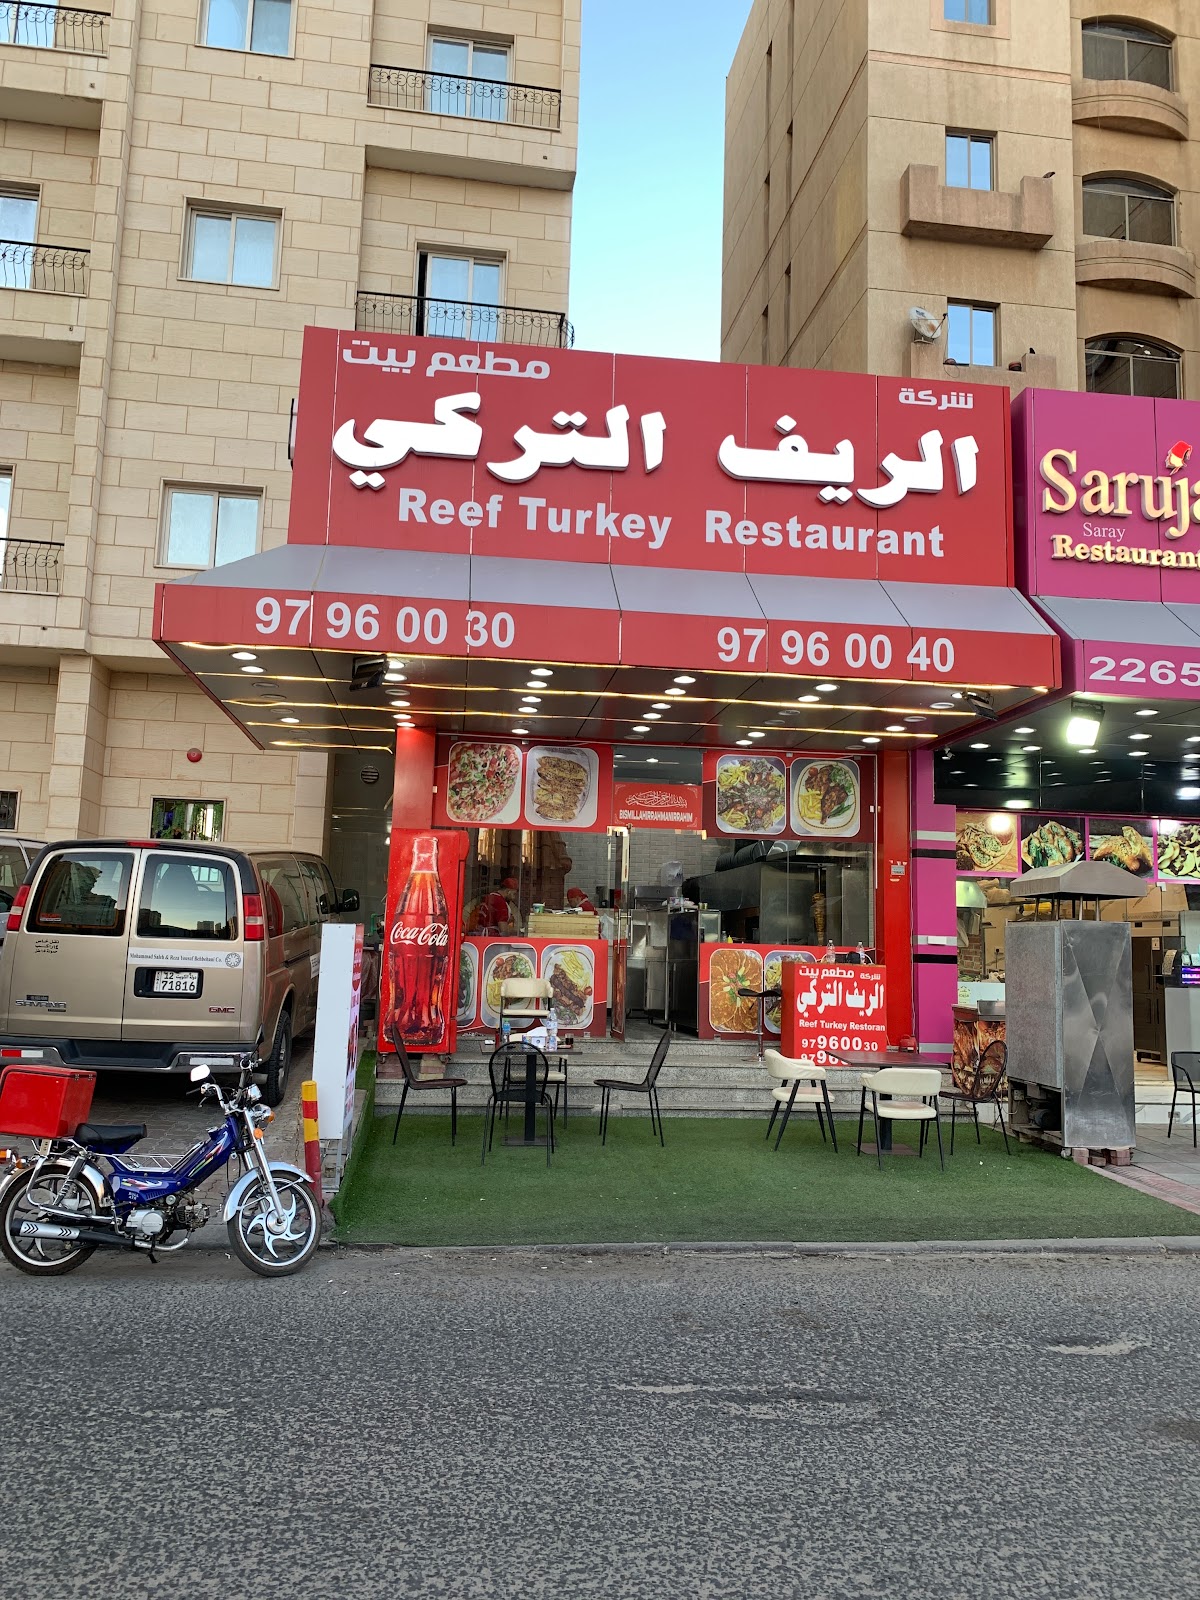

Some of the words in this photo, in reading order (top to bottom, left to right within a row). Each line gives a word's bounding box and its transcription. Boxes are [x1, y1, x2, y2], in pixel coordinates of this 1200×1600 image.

[343, 340, 416, 374] بيت
[426, 351, 550, 379] مطعم
[899, 387, 974, 410] شركة
[332, 391, 666, 490] التركي
[717, 414, 979, 509] الريف
[399, 487, 503, 529] Reef
[518, 495, 672, 550] Turkey
[705, 509, 944, 558] Restaurant
[1083, 522, 1126, 542] Saray
[255, 596, 310, 636] 97
[326, 601, 380, 641] 96
[396, 606, 448, 645] 00
[464, 610, 515, 649] 30
[717, 626, 767, 663] 97
[780, 629, 830, 667] 96
[844, 633, 892, 670] 00
[906, 636, 955, 672] 40
[390, 921, 449, 947] Coca-Cola
[163, 972, 174, 980] 12
[799, 965, 819, 979] بيت
[821, 967, 855, 979] مطعم
[860, 972, 881, 981] شركة
[161, 980, 196, 992] 71816
[797, 978, 842, 1018] التركي
[846, 980, 885, 1017] الريف
[208, 1005, 235, 1014] GMC
[799, 1019, 818, 1028] Reef
[820, 1020, 848, 1031] Turkey
[849, 1022, 886, 1031] Restoran
